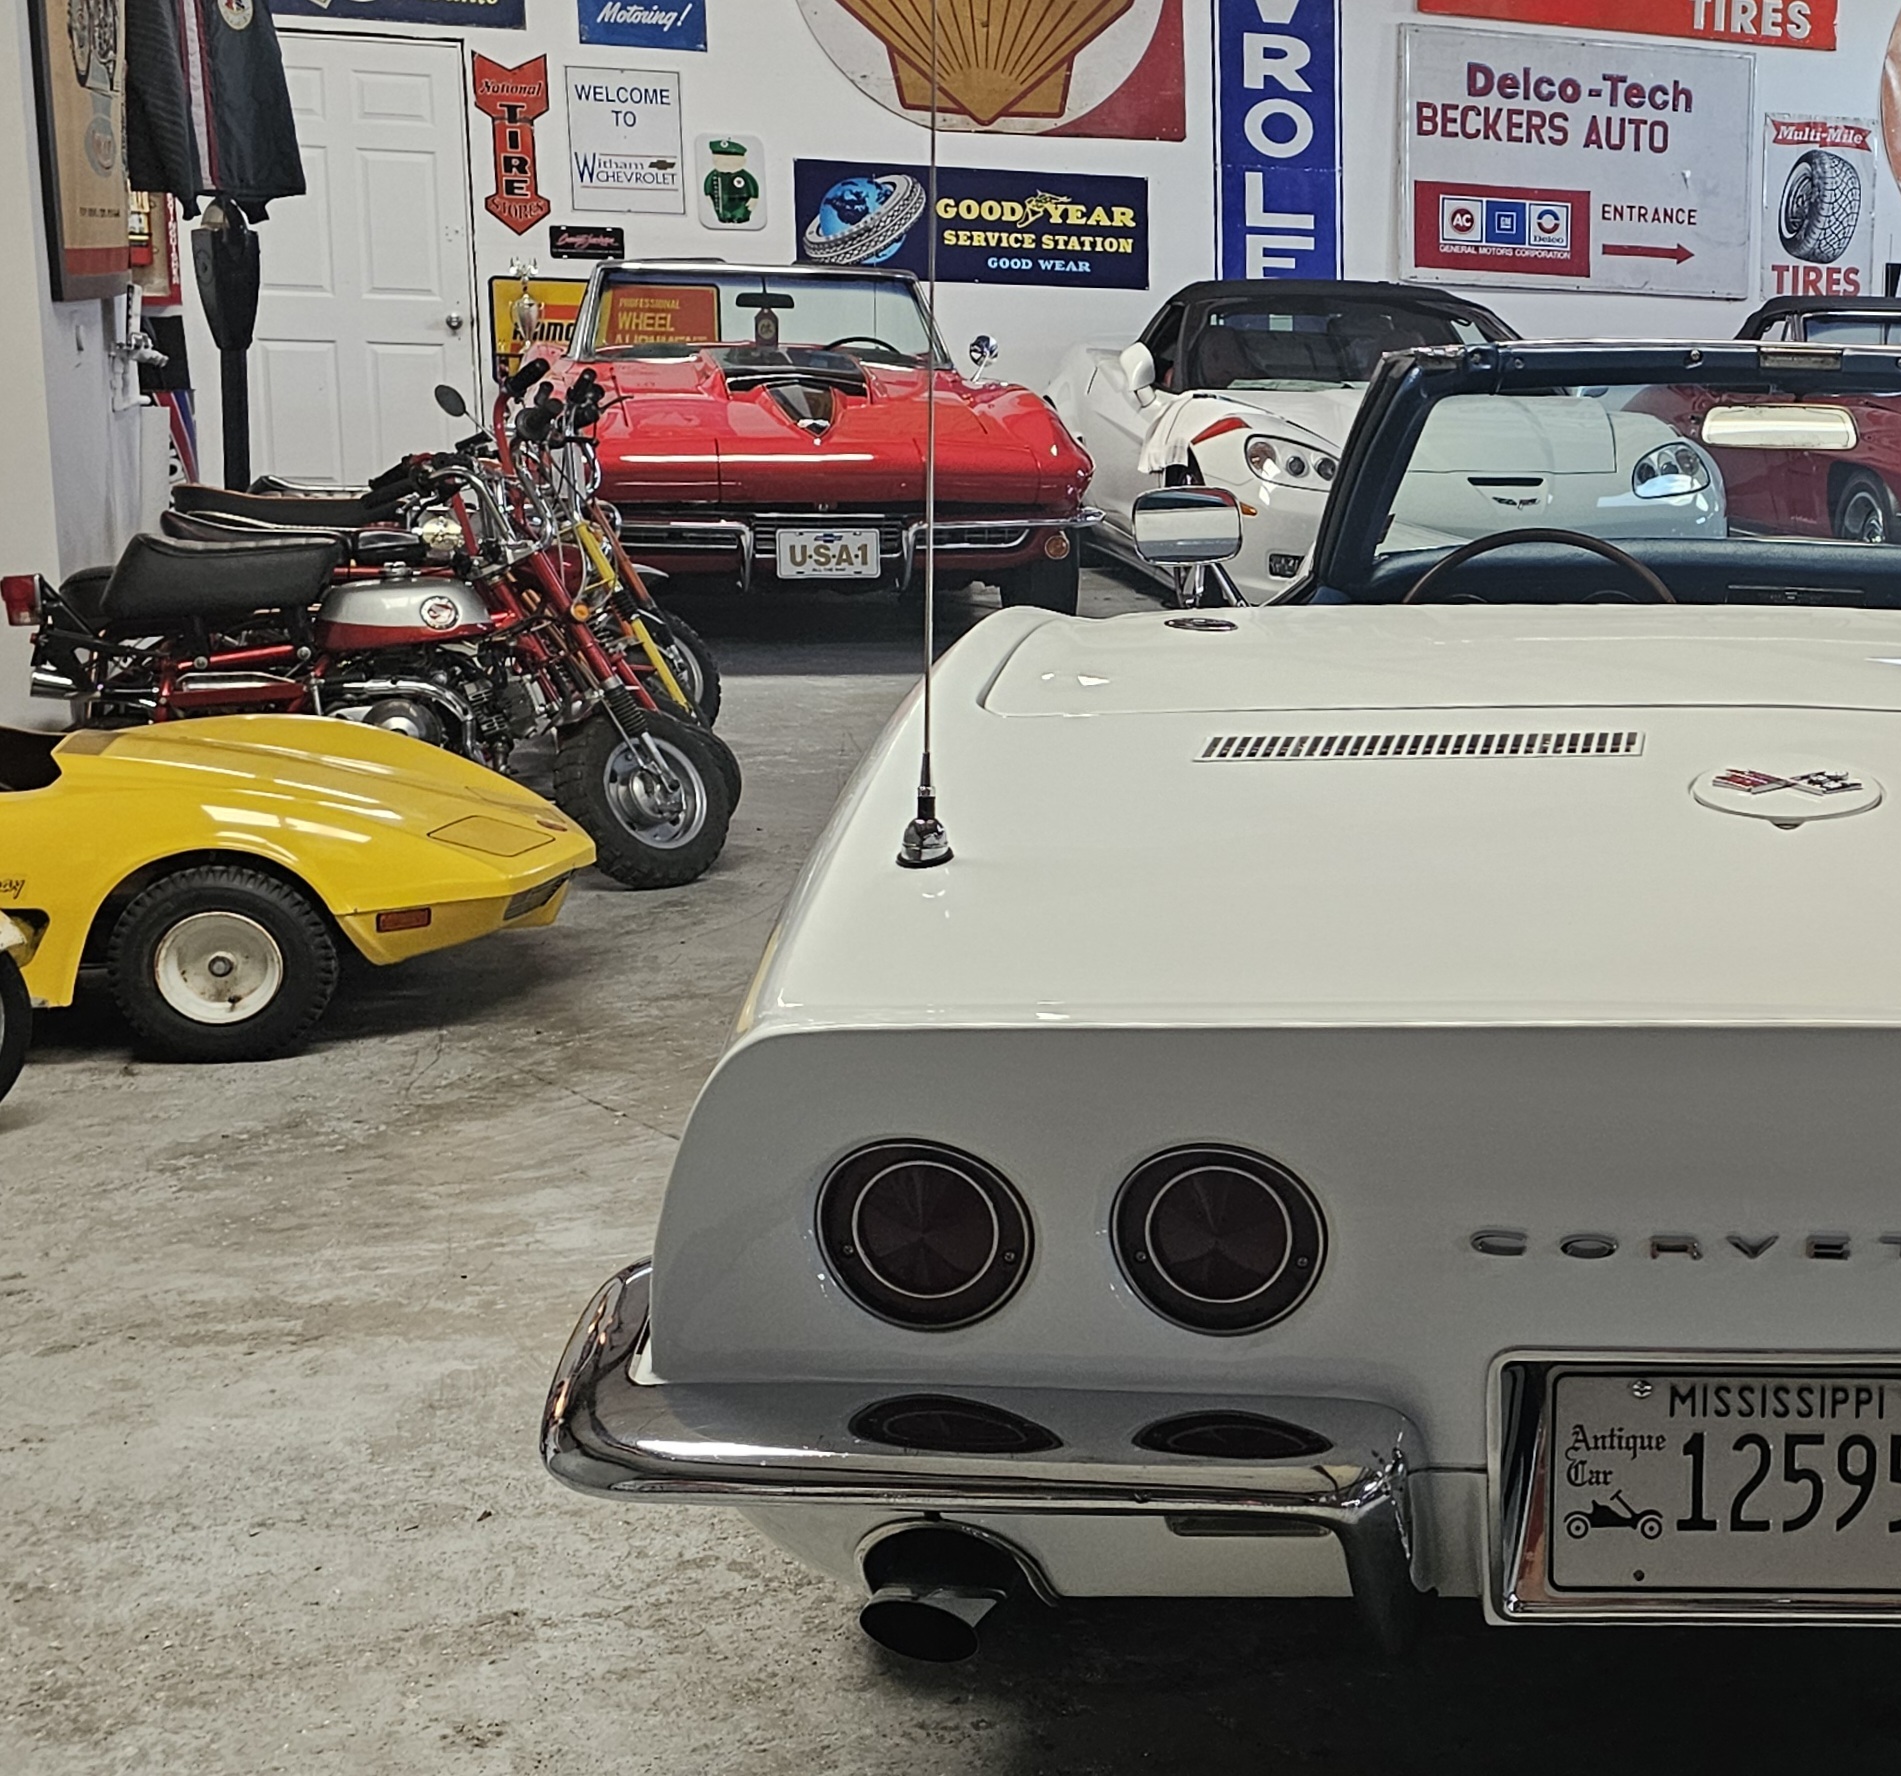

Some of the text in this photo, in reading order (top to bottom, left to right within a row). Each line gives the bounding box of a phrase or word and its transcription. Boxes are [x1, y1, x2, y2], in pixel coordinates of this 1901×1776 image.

[596, 2, 687, 31] Motoring!
[1690, 0, 1813, 40] TIRES
[480, 80, 542, 97] National
[575, 84, 671, 106] WELCOME
[1466, 62, 1694, 113] Delco-Tech
[612, 110, 637, 128] TO
[1415, 102, 1670, 154] BECKERS AUTO
[1778, 124, 1869, 147] Multi-Mile
[498, 102, 529, 198] TIRE
[574, 152, 645, 184] Witham
[596, 171, 677, 186] CHEVROLET
[490, 197, 544, 220] STORES
[1453, 213, 1471, 226] AC
[1602, 204, 1697, 225] ENTRANCE
[943, 229, 1133, 253] SERVICE STATION
[1533, 235, 1564, 244] Delco
[1440, 245, 1571, 259] GENERAL MOTORS CORPORATION
[987, 257, 1091, 273] GOOD WEAR
[1771, 264, 1862, 298] TIRES
[619, 298, 680, 309] PROFESSIONAL
[618, 311, 675, 331] WHEEL
[1670, 1385, 1885, 1420] MISSISSIPPI
[1569, 1424, 1666, 1460] Antique
[1566, 1448, 1614, 1488] Car
